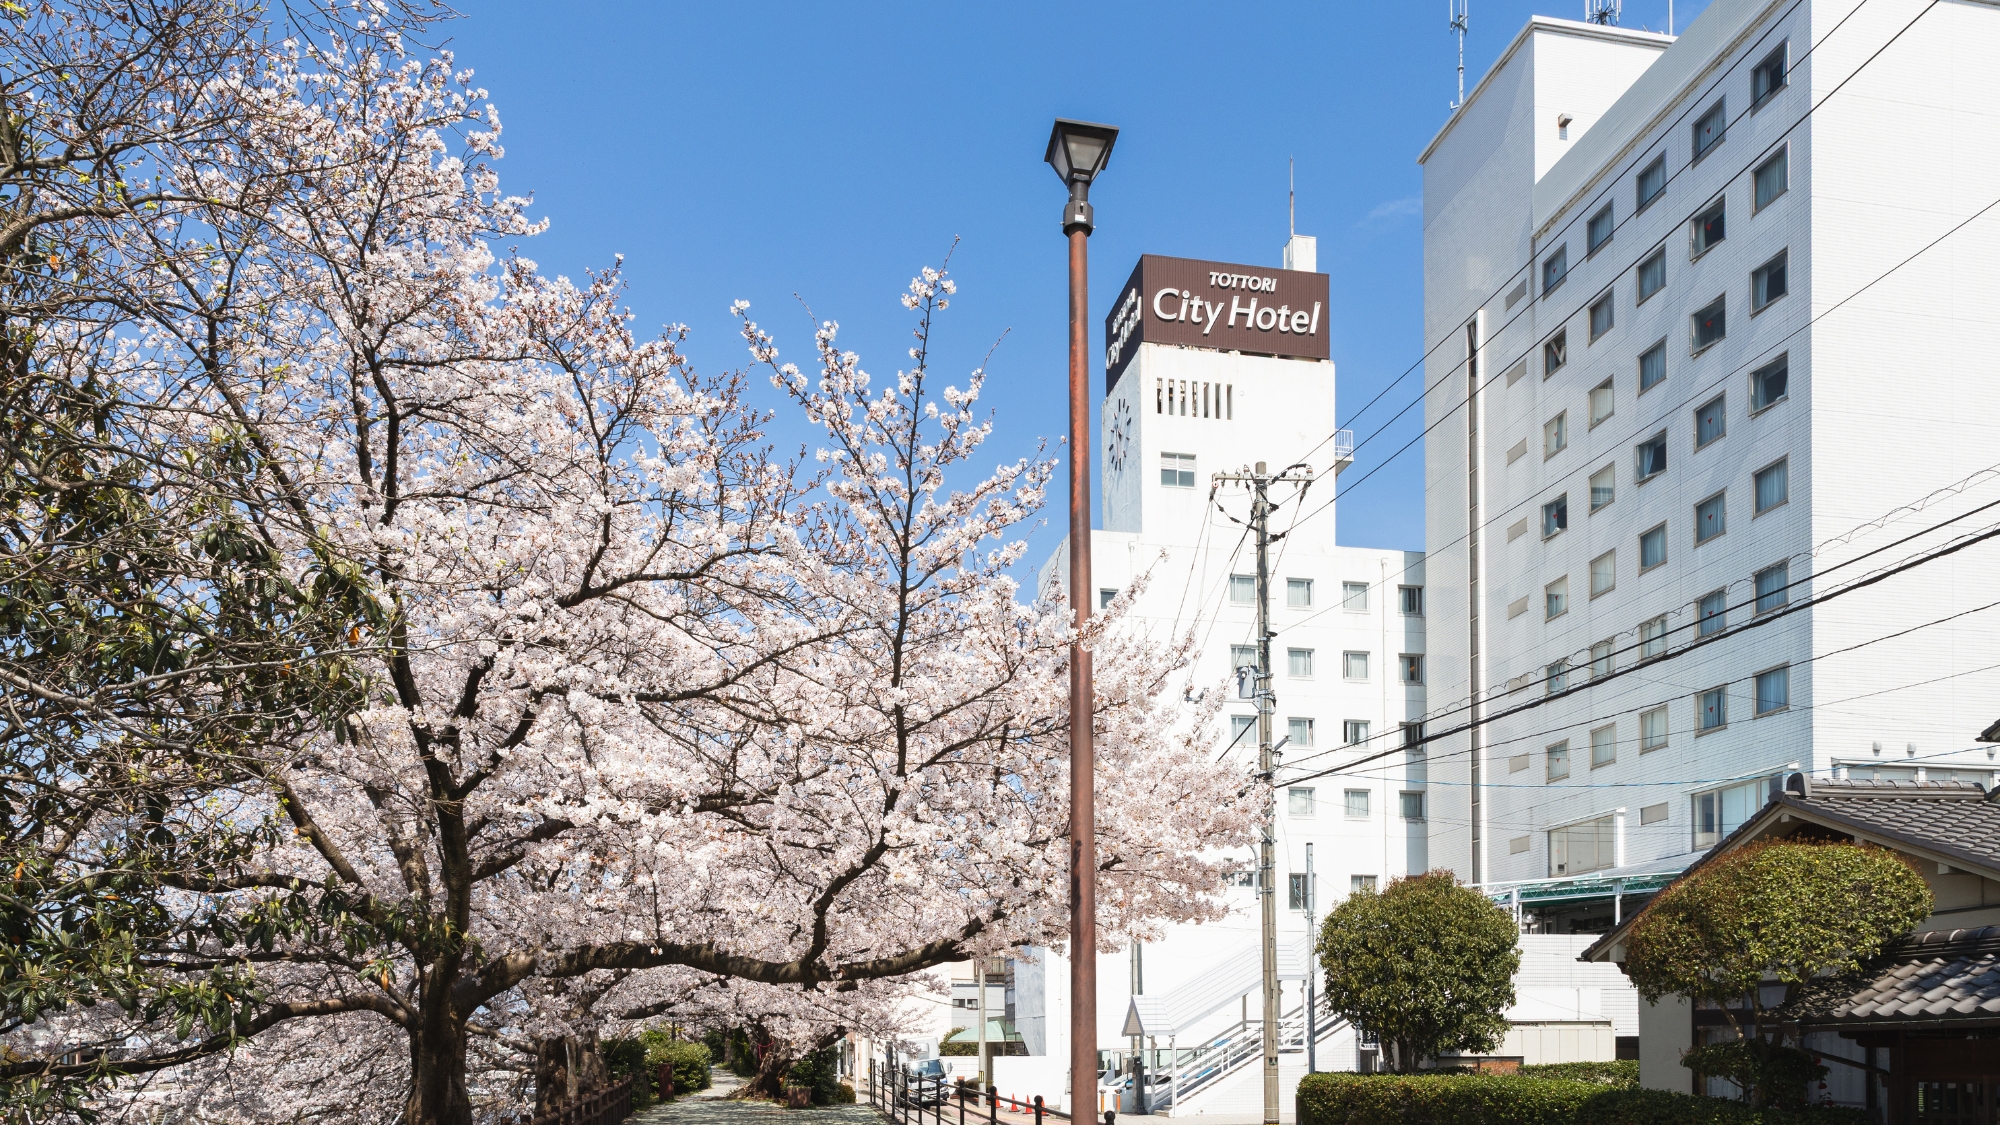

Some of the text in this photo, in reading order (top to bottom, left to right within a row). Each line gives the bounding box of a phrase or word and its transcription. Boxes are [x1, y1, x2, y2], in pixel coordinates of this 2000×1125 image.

[1209, 271, 1277, 292] TOTTORI
[1153, 288, 1225, 335] City
[1228, 295, 1321, 335] Hotel
